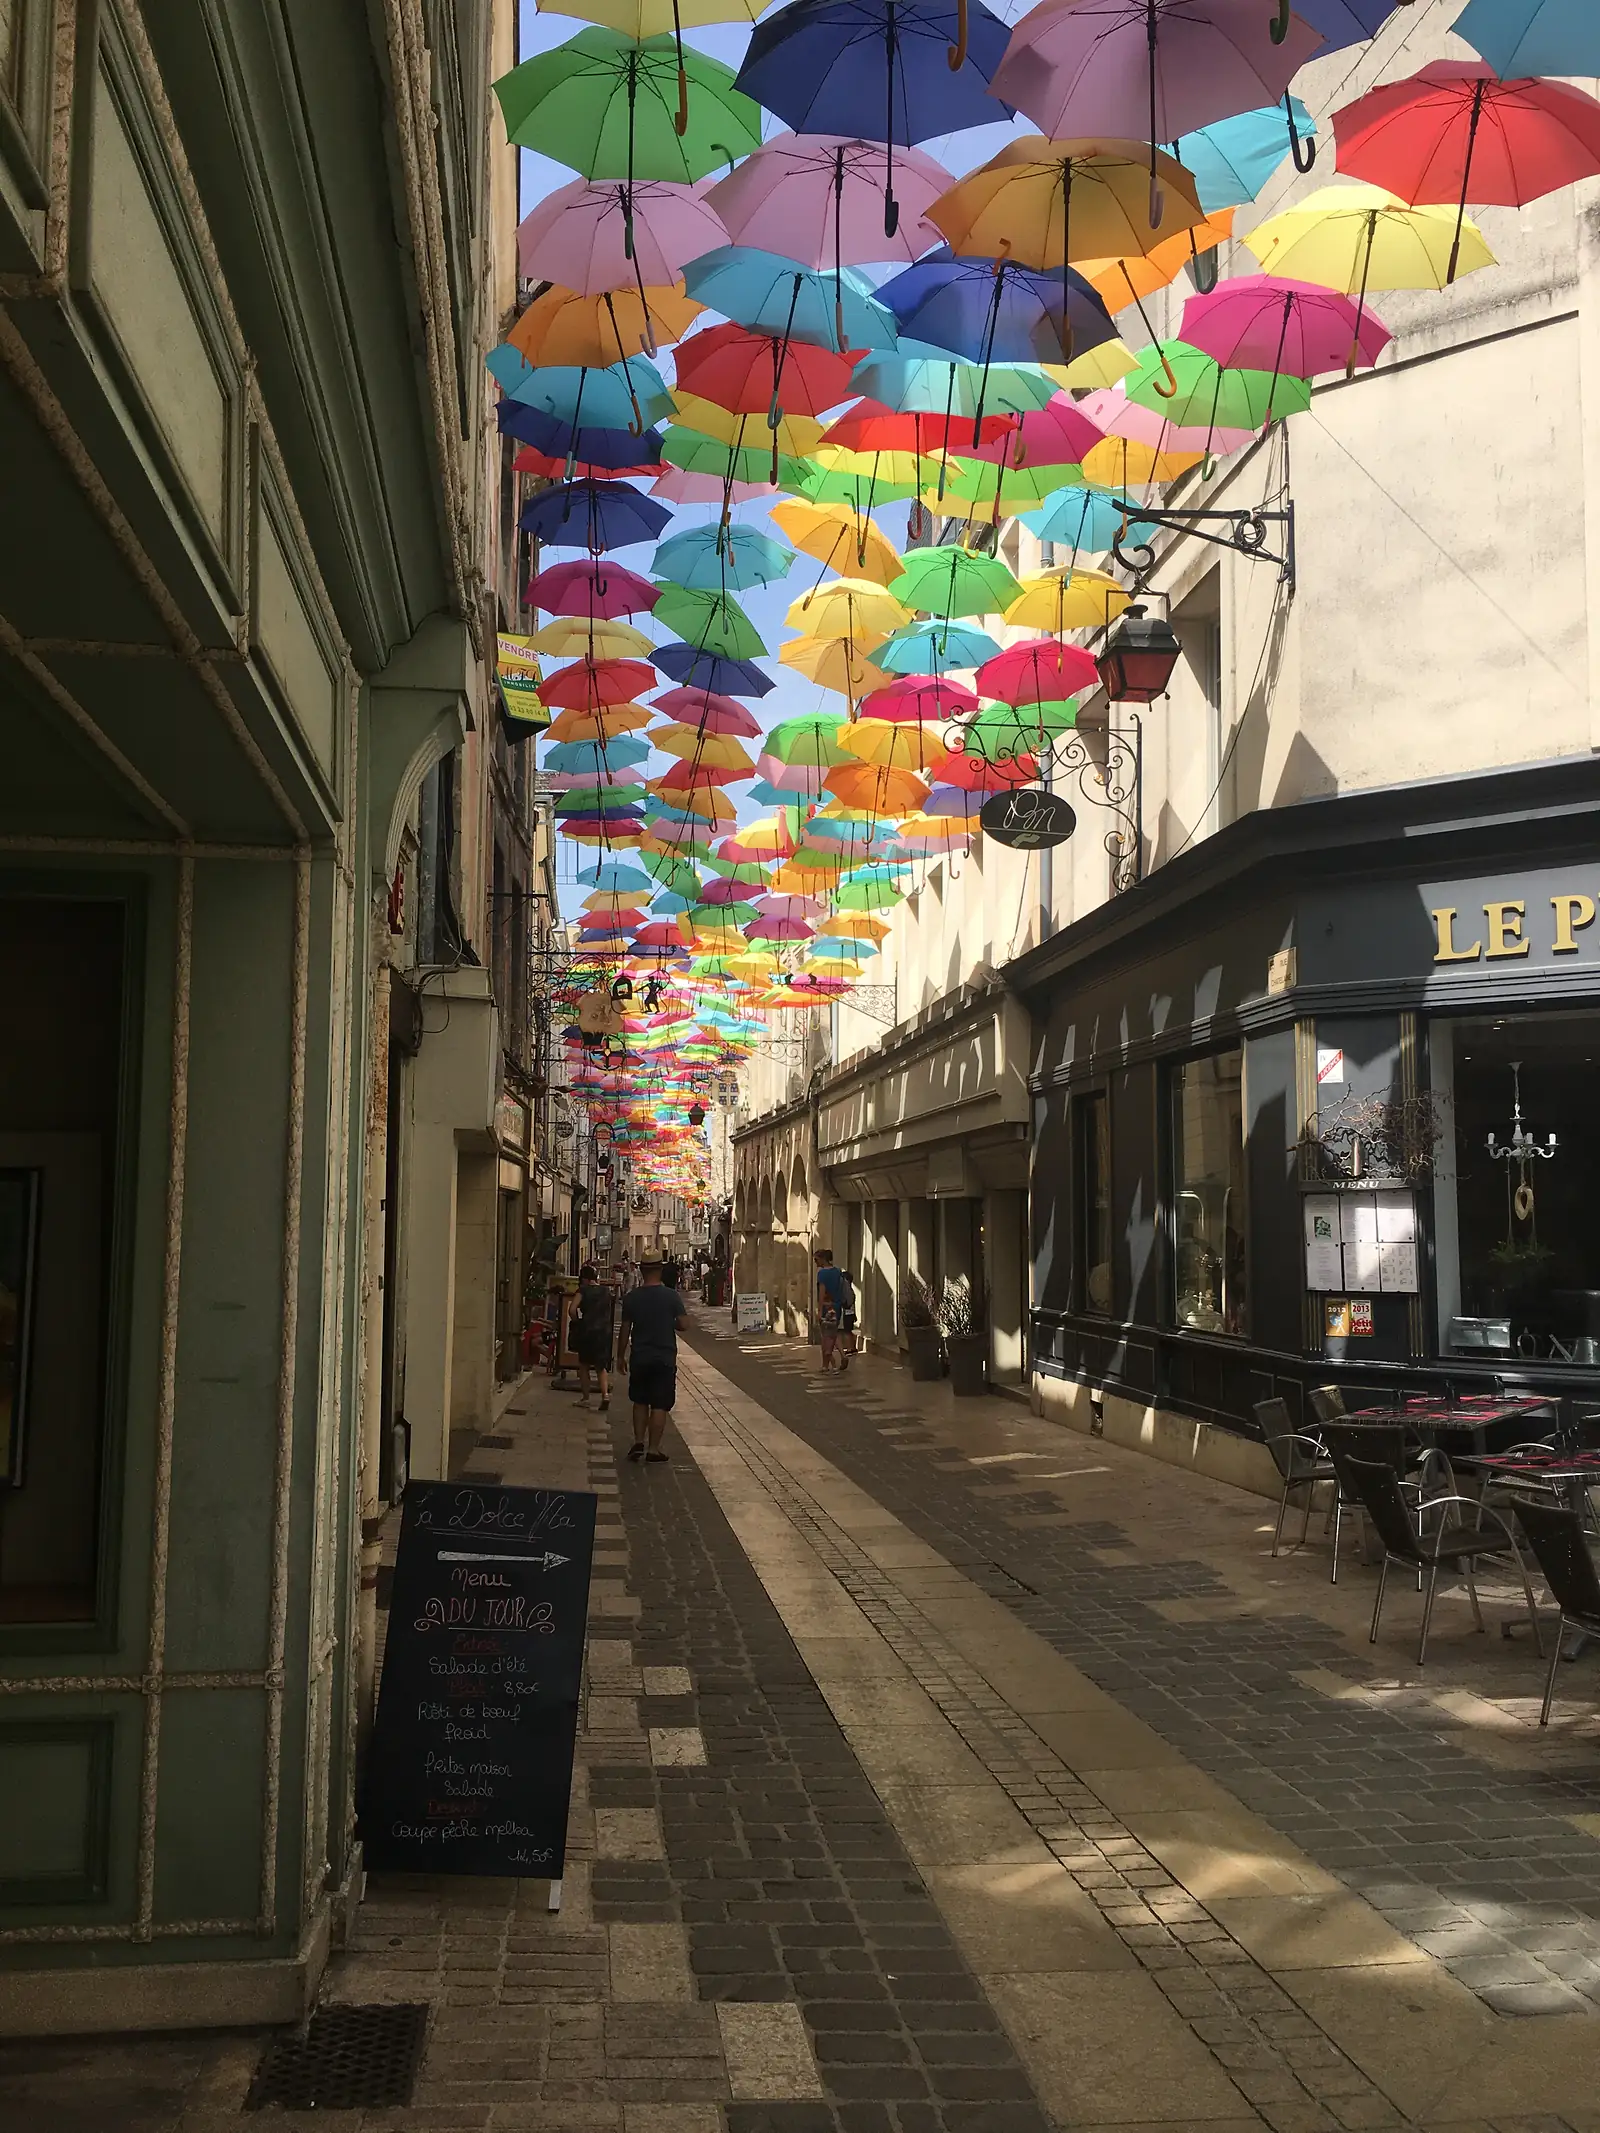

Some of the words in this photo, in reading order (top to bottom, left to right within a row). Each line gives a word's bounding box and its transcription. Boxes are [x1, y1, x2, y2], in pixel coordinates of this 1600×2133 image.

[497, 639, 538, 662] VENDRE
[1432, 900, 1530, 964] LE
[1550, 893, 1600, 956] P
[1332, 1180, 1380, 1190] MENU
[1352, 1304, 1370, 1313] 2013
[449, 1489, 525, 1529] Dolce
[528, 1490, 576, 1541] Vita
[451, 1567, 512, 1591] Menu
[448, 1597, 476, 1623] DU
[483, 1596, 528, 1627] JOUR
[429, 1656, 489, 1675] Salade
[491, 1656, 528, 1674] d'été
[459, 1703, 476, 1719] de
[469, 1760, 513, 1782] maison
[445, 1780, 495, 1797] Salade
[391, 1820, 437, 1844] Coupe
[442, 1819, 480, 1843] pêche
